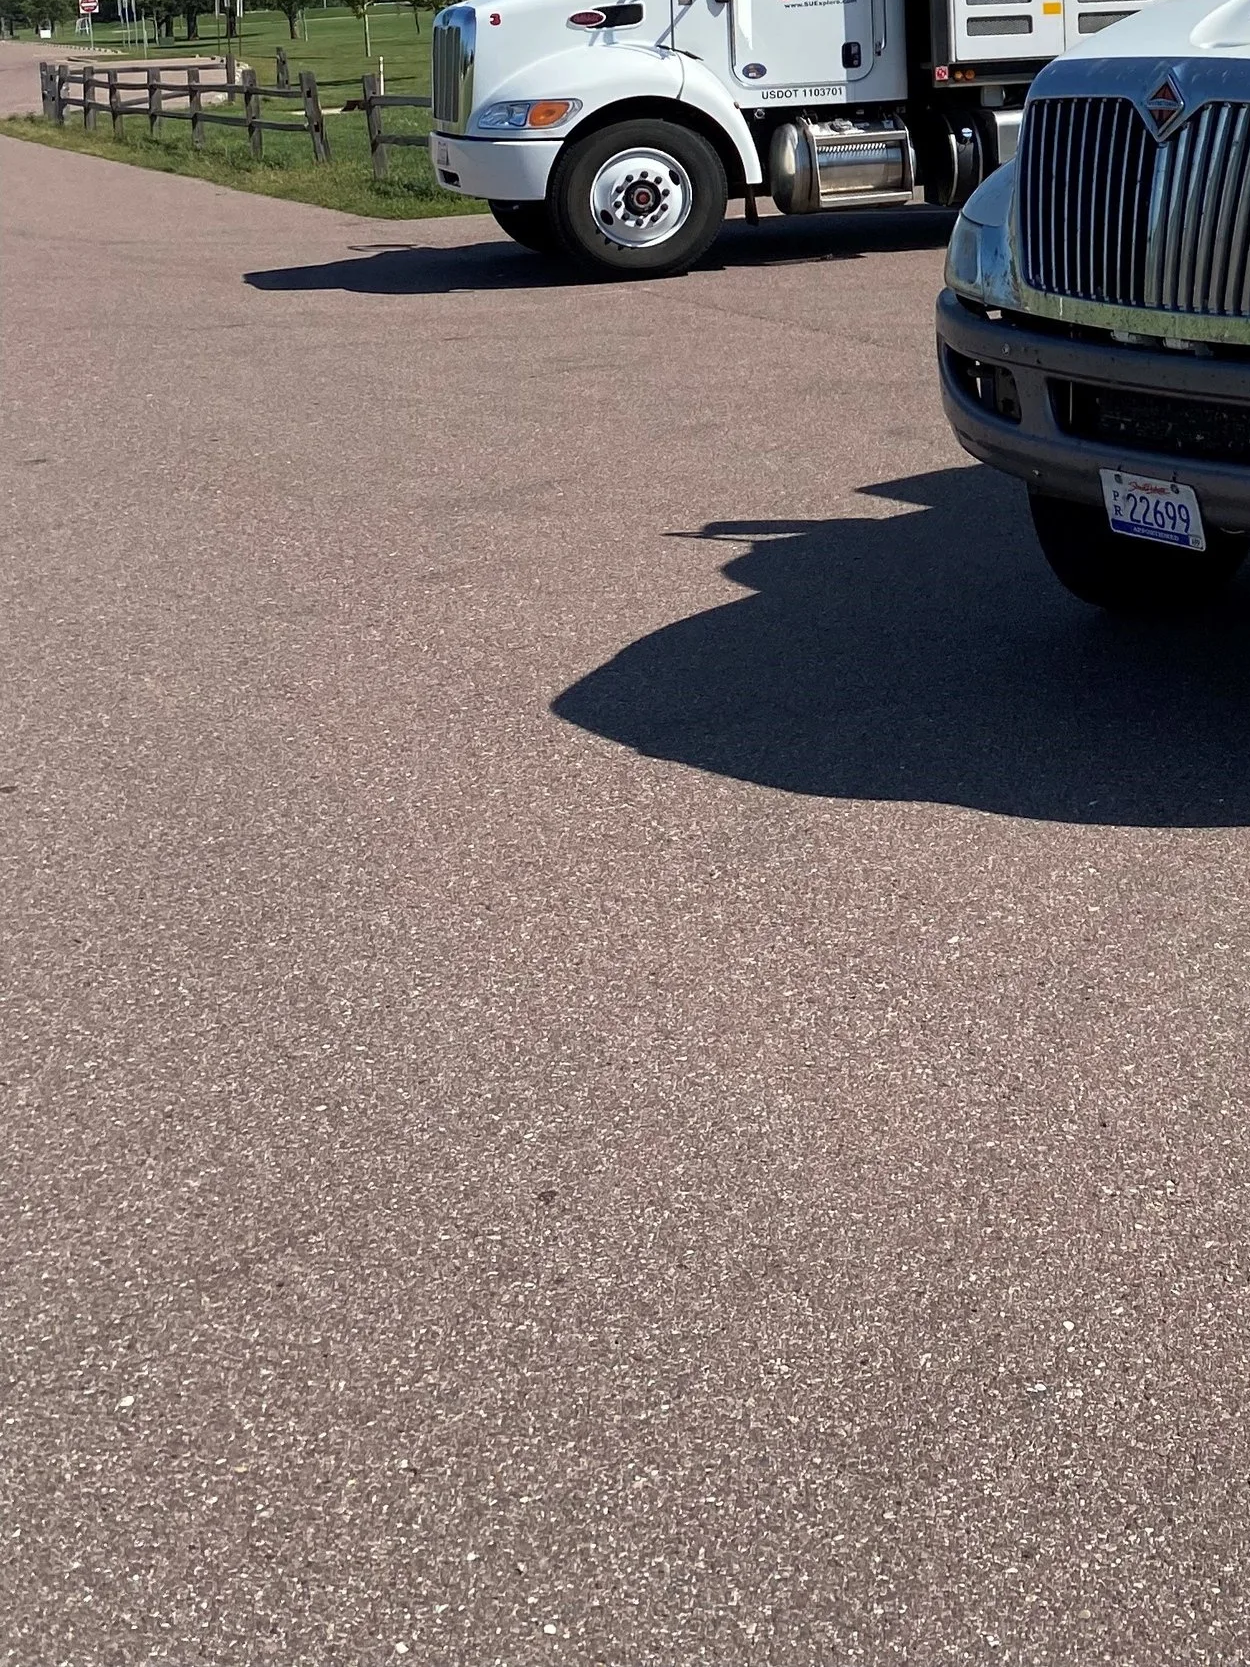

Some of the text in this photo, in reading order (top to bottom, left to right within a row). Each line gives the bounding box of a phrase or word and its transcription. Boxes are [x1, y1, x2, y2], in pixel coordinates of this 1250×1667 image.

[489, 13, 501, 26] 3
[761, 86, 842, 100] USDOT 1103701
[1126, 492, 1191, 534] 22699
